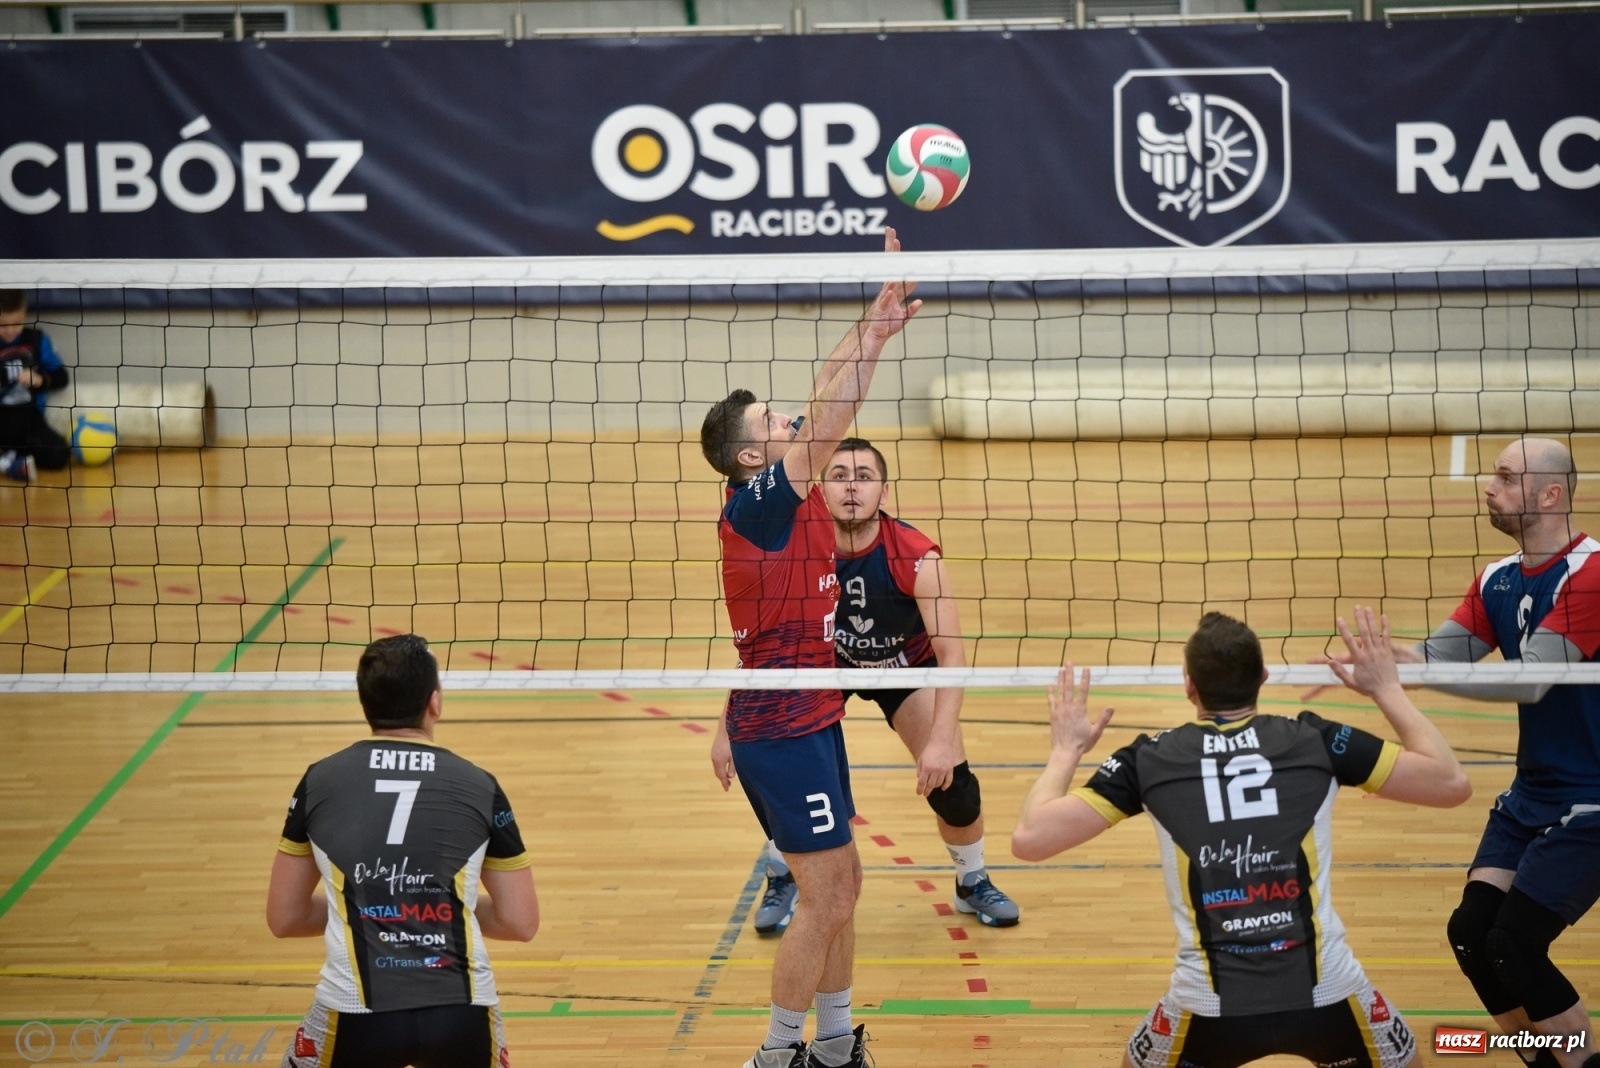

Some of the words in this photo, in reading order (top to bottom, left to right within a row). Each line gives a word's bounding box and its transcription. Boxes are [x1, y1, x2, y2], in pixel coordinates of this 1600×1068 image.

[0, 115, 367, 214] CIBÓRZ
[1396, 116, 1600, 194] RAC
[711, 201, 888, 237] RACIBÓRZ
[369, 748, 436, 771] ENTER
[1203, 726, 1260, 754] ENTER
[375, 779, 421, 845] 7
[806, 792, 835, 834] 3
[1200, 753, 1279, 823] 12
